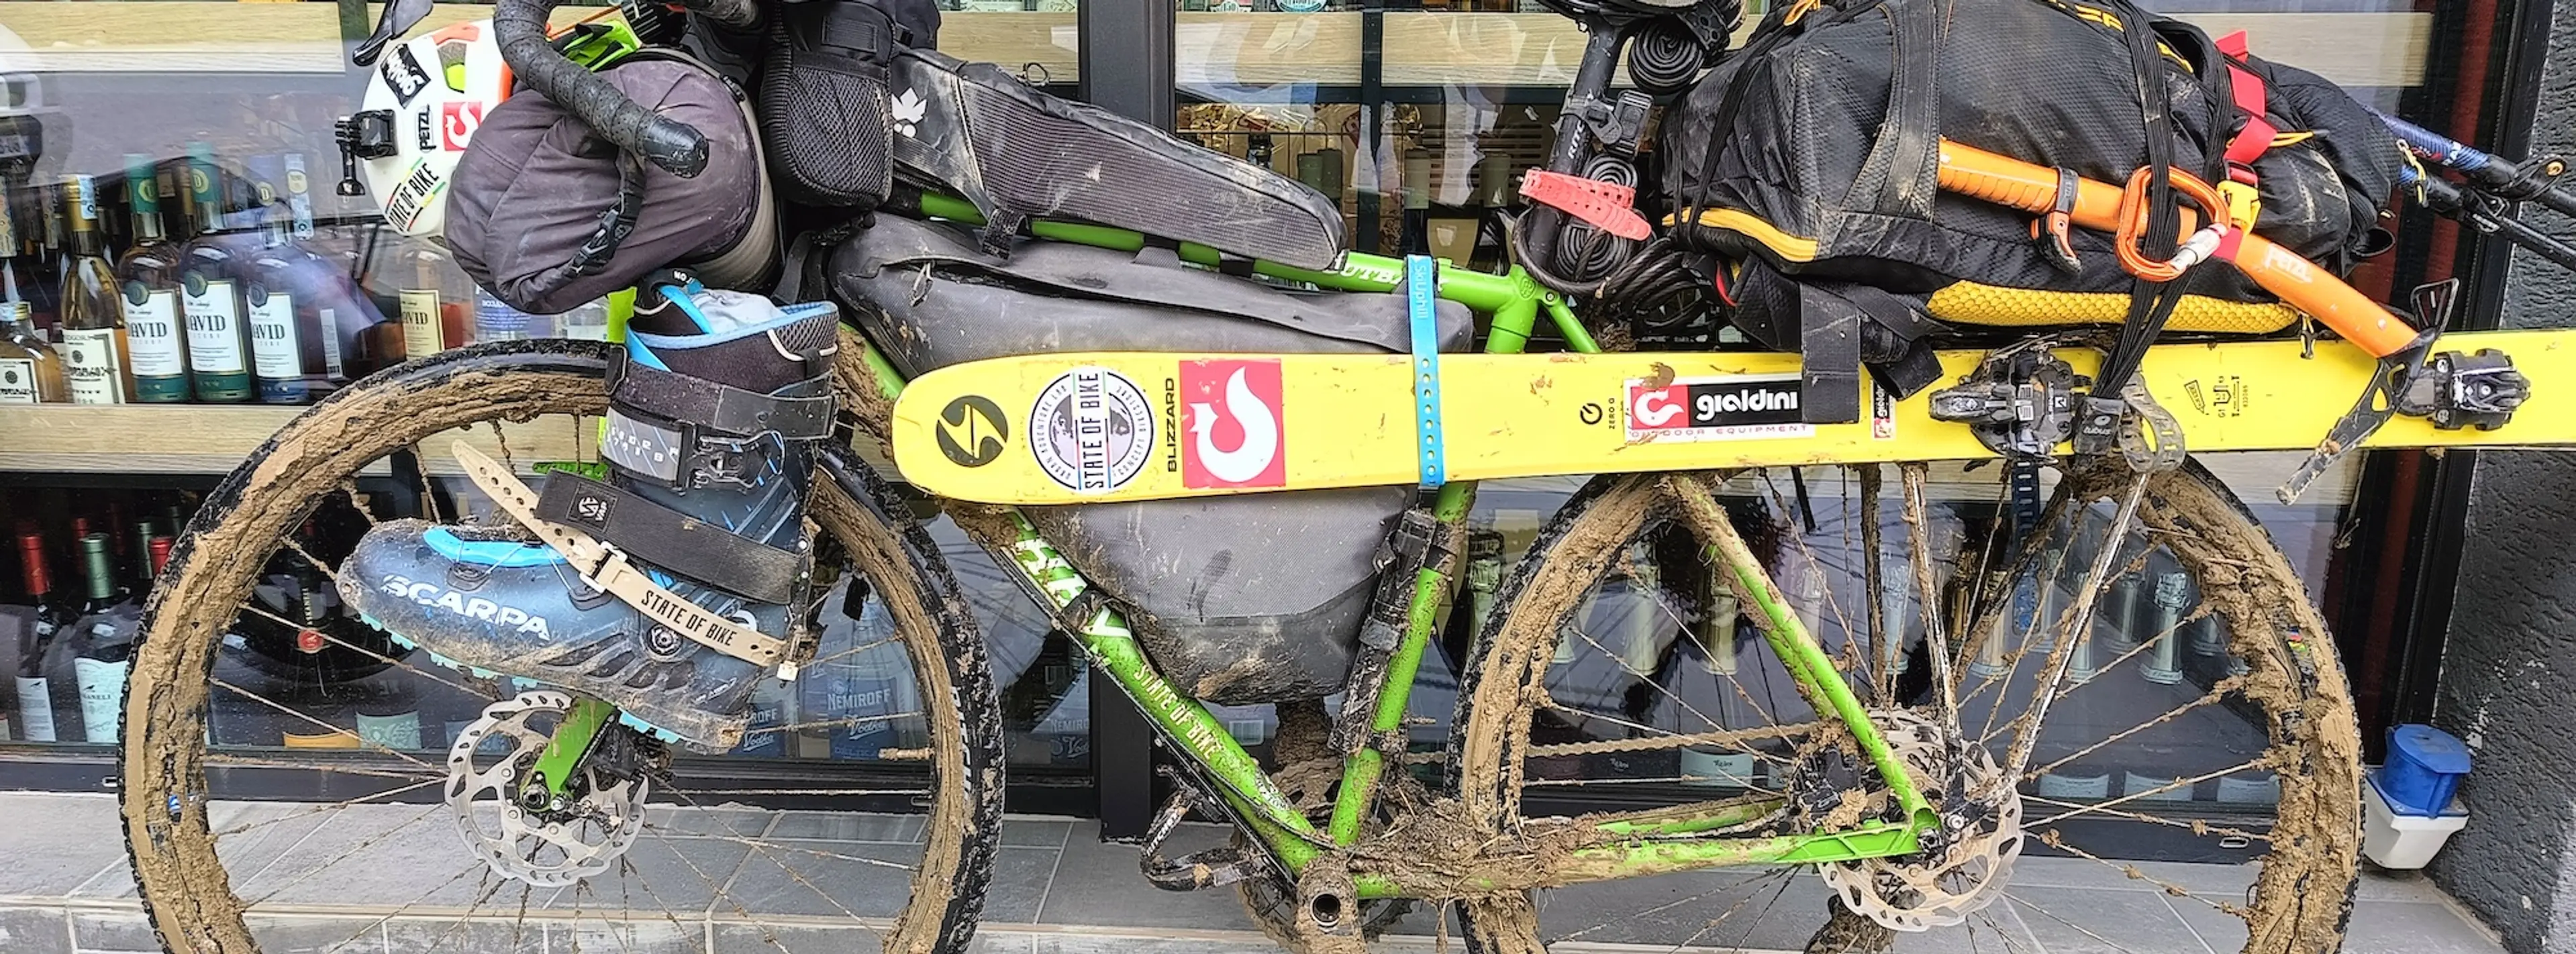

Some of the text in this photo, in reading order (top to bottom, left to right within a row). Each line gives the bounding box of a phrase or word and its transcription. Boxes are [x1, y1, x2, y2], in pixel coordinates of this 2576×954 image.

[418, 103, 437, 151] PETZL
[399, 185, 417, 210] OF
[408, 162, 440, 197] BIKE
[1165, 378, 1177, 472] BLIZZARD
[1695, 388, 1798, 421] gialdini
[1078, 372, 1105, 489] STATE OF BIKE
[1716, 425, 1807, 435] EQUIPMENT
[381, 574, 551, 641] SCARPA
[641, 589, 738, 647] STATE OF BIKE
[827, 688, 891, 711] NEMIROFF
[1134, 664, 1225, 760] STATE OF BIKE
[743, 732, 775, 751] Vodka
[847, 715, 887, 741] Vodka
